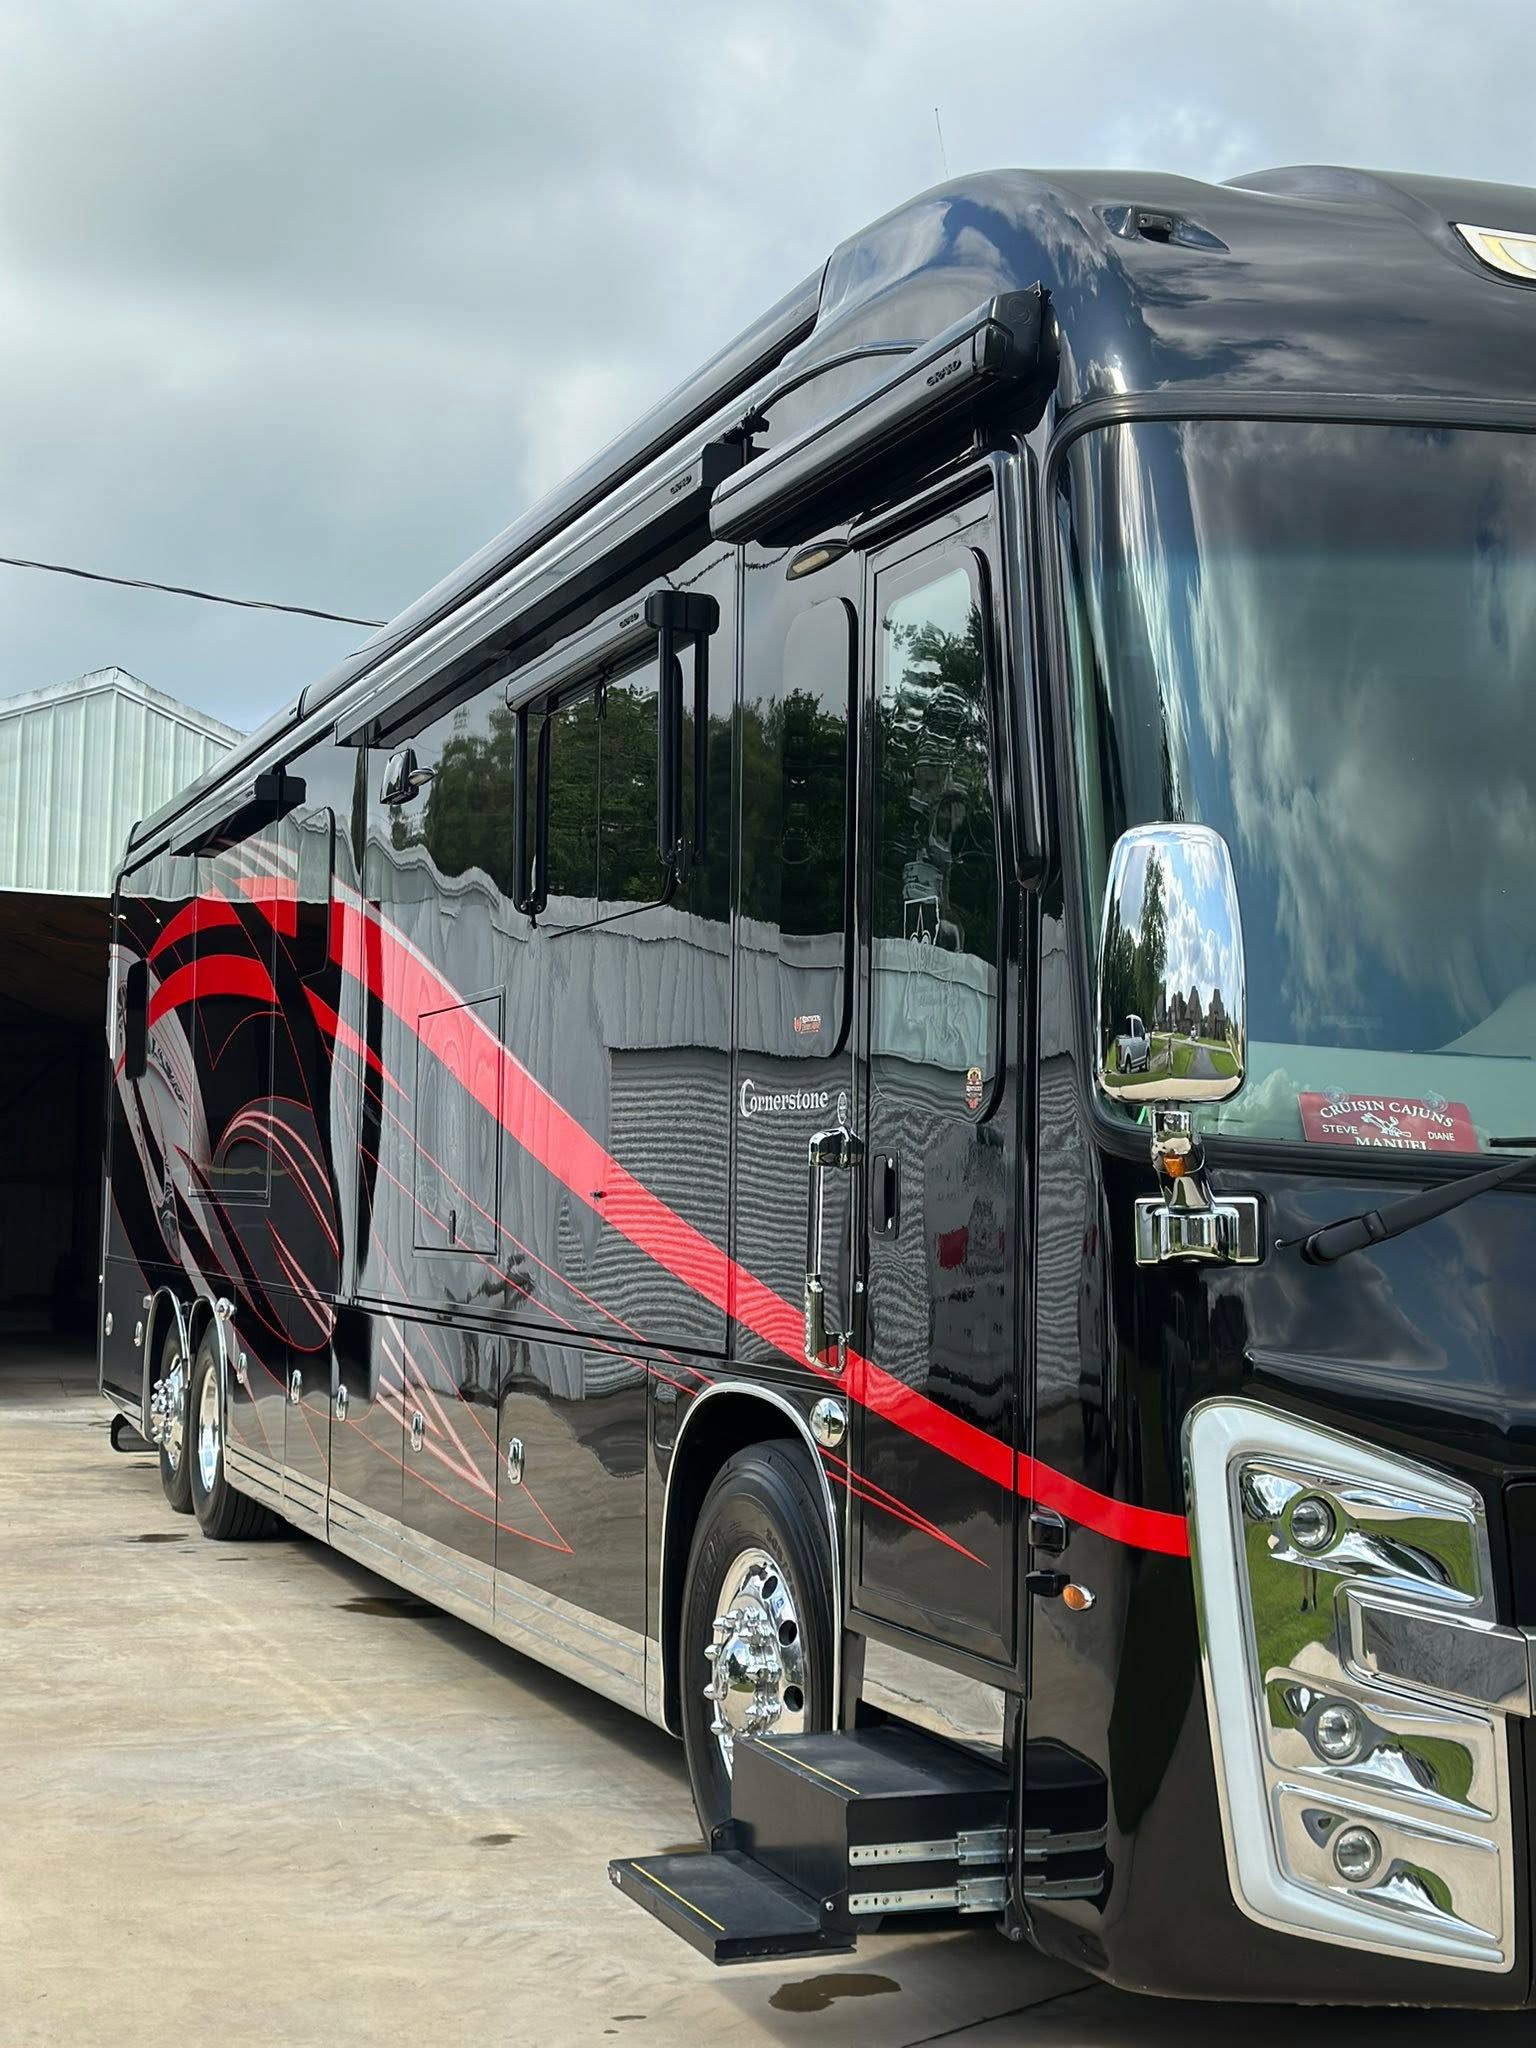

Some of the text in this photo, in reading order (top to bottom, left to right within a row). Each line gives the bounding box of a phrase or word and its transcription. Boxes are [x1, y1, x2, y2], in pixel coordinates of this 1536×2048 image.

[740, 1079, 828, 1117] Cornerstone
[1320, 1100, 1454, 1127] CRUISIN CAJUNS
[1322, 1124, 1359, 1135] STEVE
[1427, 1131, 1456, 1142] DIANE
[1354, 1136, 1432, 1151] MANUEL
